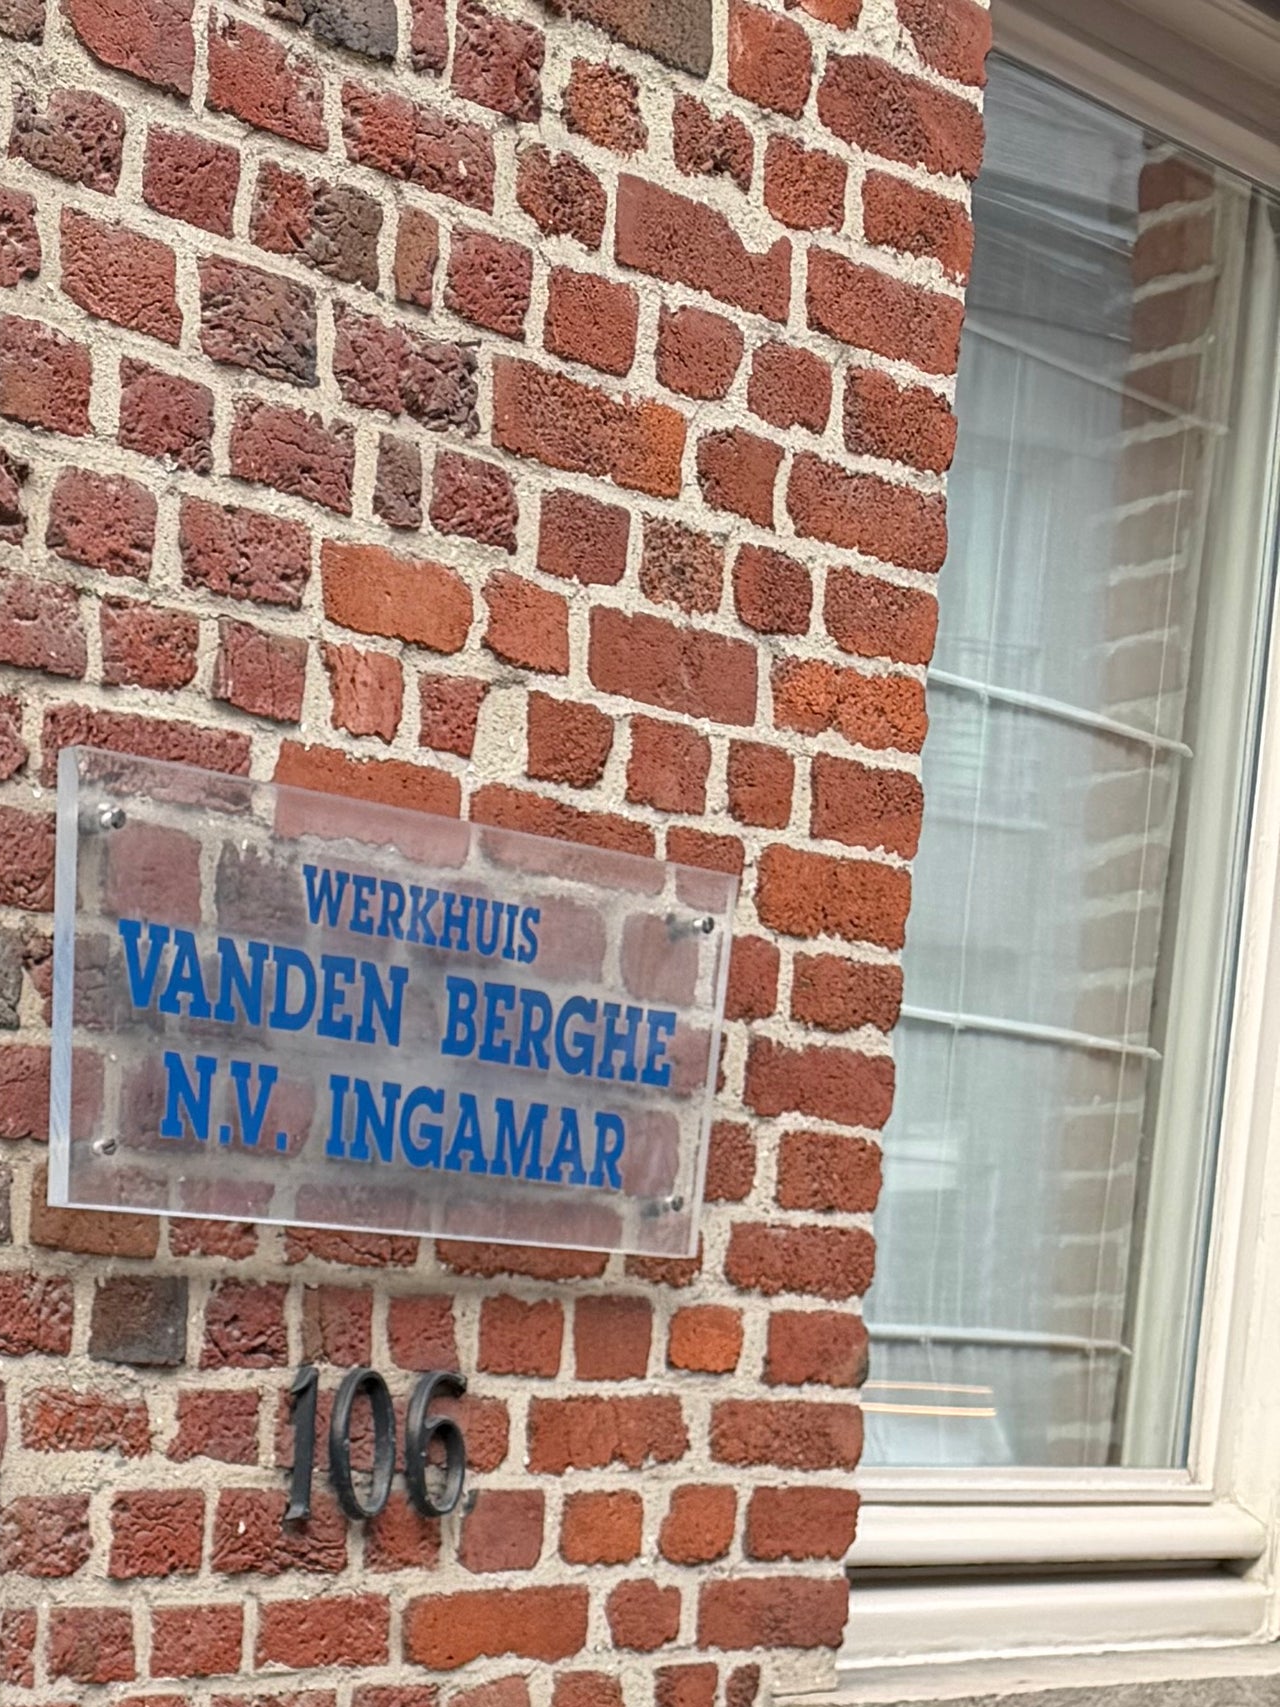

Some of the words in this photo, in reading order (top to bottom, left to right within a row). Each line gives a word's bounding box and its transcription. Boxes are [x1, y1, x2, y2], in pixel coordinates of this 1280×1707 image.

[302, 864, 541, 965] WERKHUIS
[117, 918, 410, 1048] VANDEN
[440, 975, 677, 1088] BERGHE
[160, 1050, 288, 1152] N.V.
[325, 1073, 626, 1190] INGAMAR
[285, 1366, 468, 1520] 106
